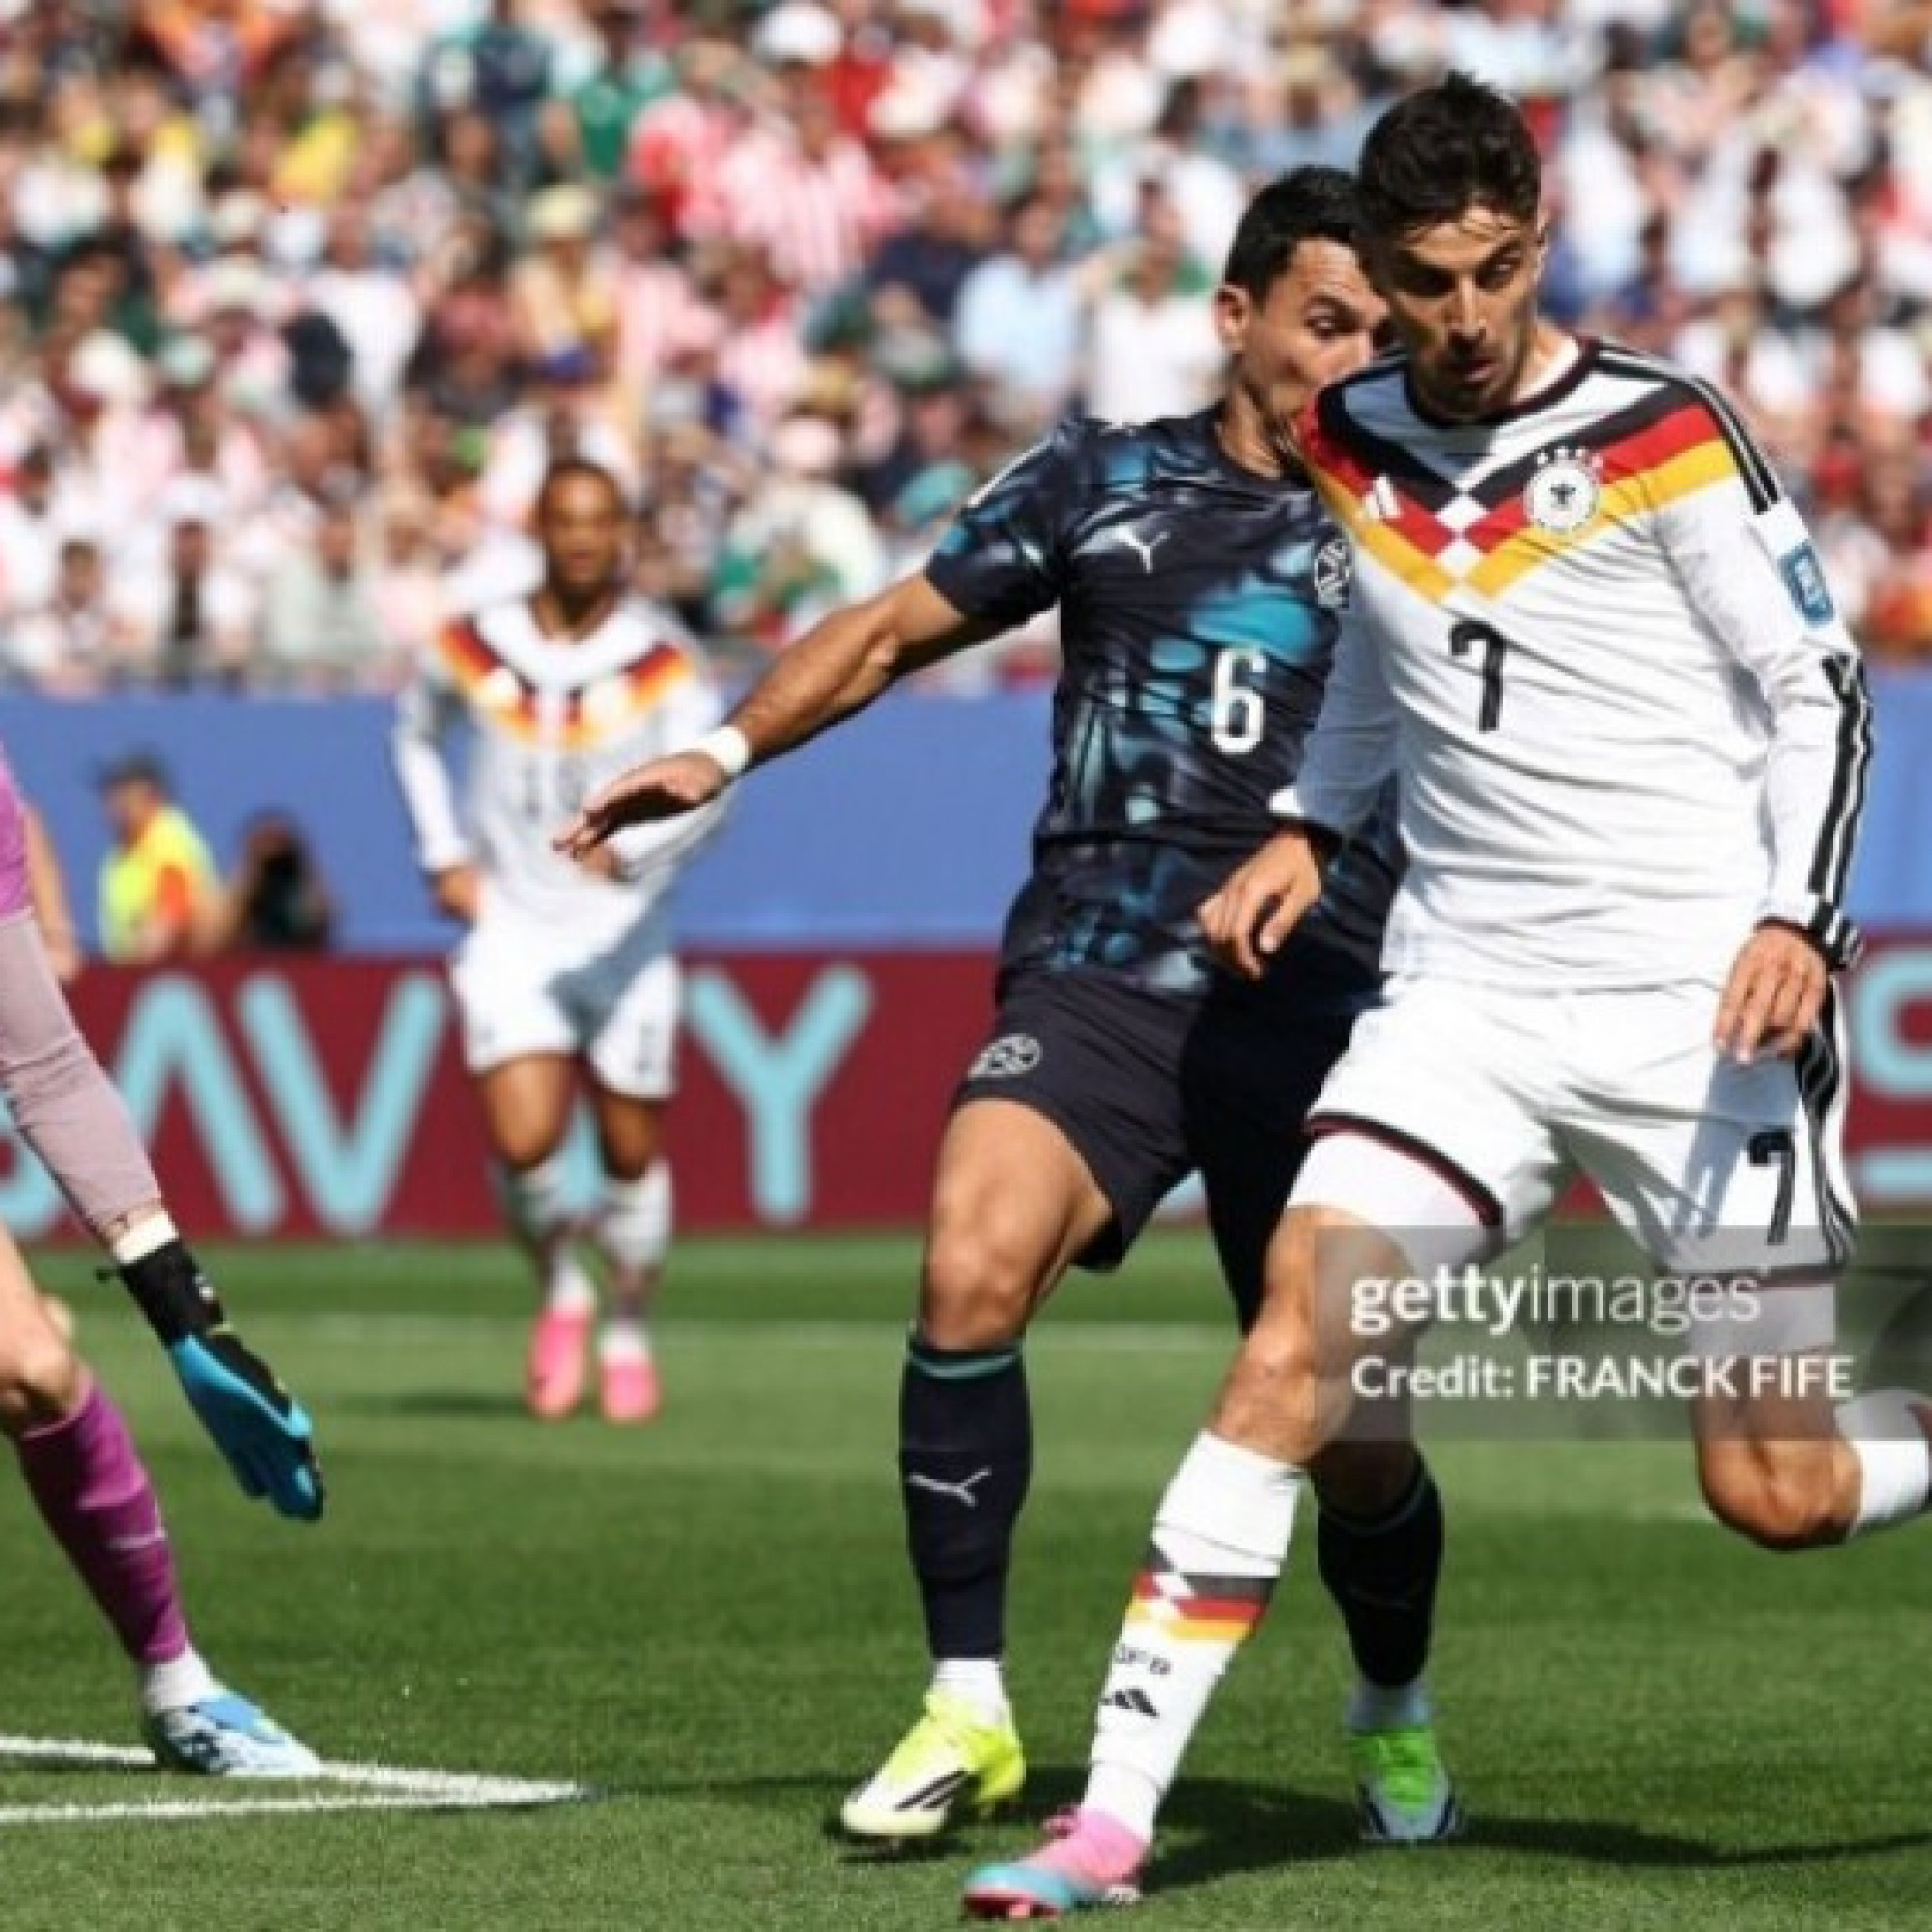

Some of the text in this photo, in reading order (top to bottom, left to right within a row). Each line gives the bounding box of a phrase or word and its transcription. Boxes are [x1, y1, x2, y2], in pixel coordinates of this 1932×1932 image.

[1211, 647, 1267, 753] 6
[1449, 621, 1504, 733] 7
[1749, 1130, 1795, 1245] 7
